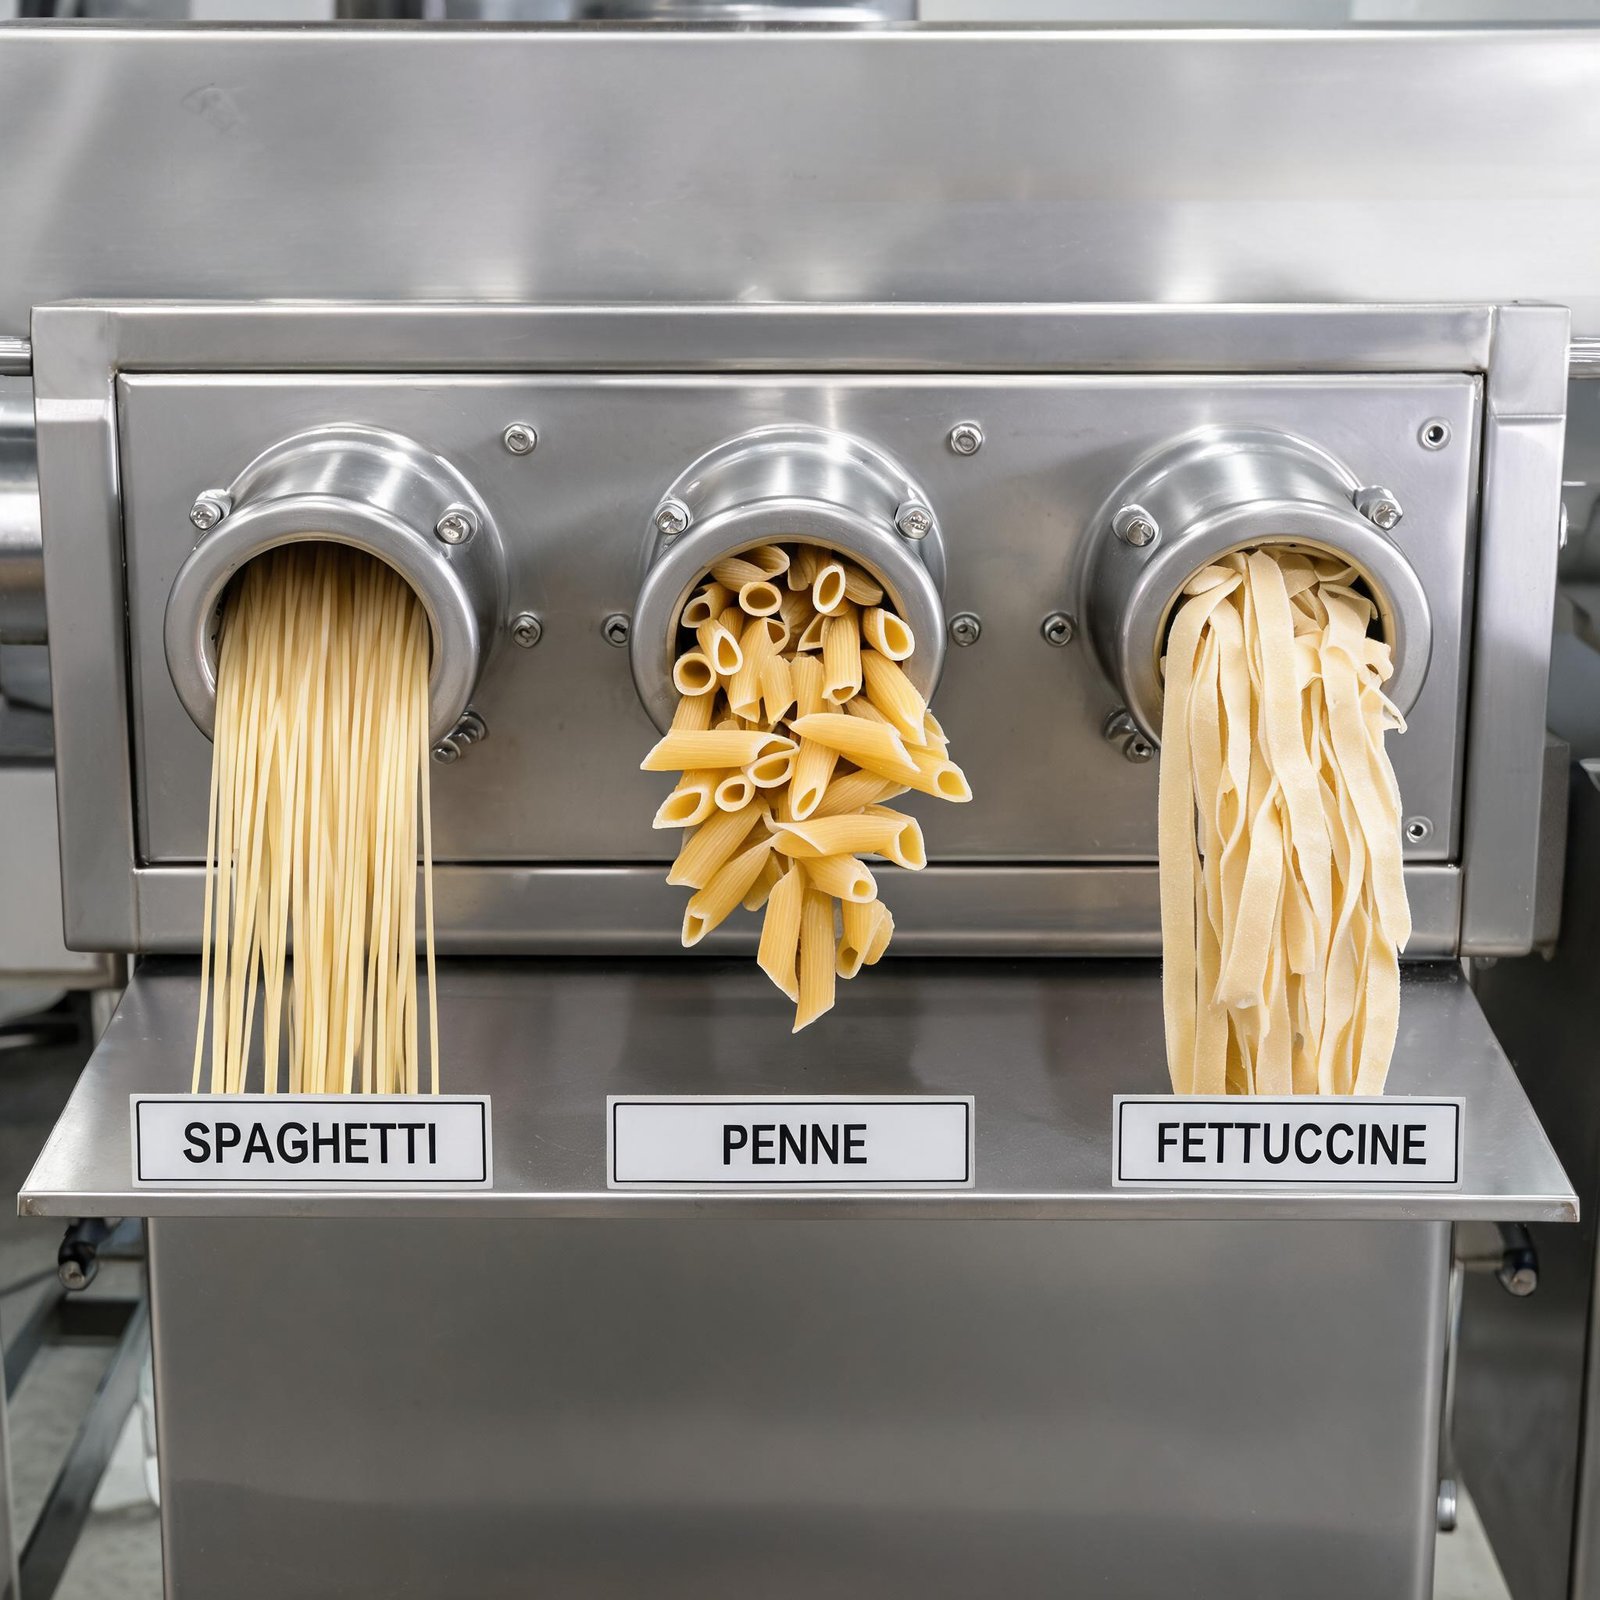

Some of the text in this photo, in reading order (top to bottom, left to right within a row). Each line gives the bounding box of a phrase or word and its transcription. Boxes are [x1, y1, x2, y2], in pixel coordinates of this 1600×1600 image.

[182, 1121, 437, 1165] SPAGHETTI
[723, 1123, 868, 1166] PENNE
[1157, 1122, 1427, 1166] FETTUCCINE
